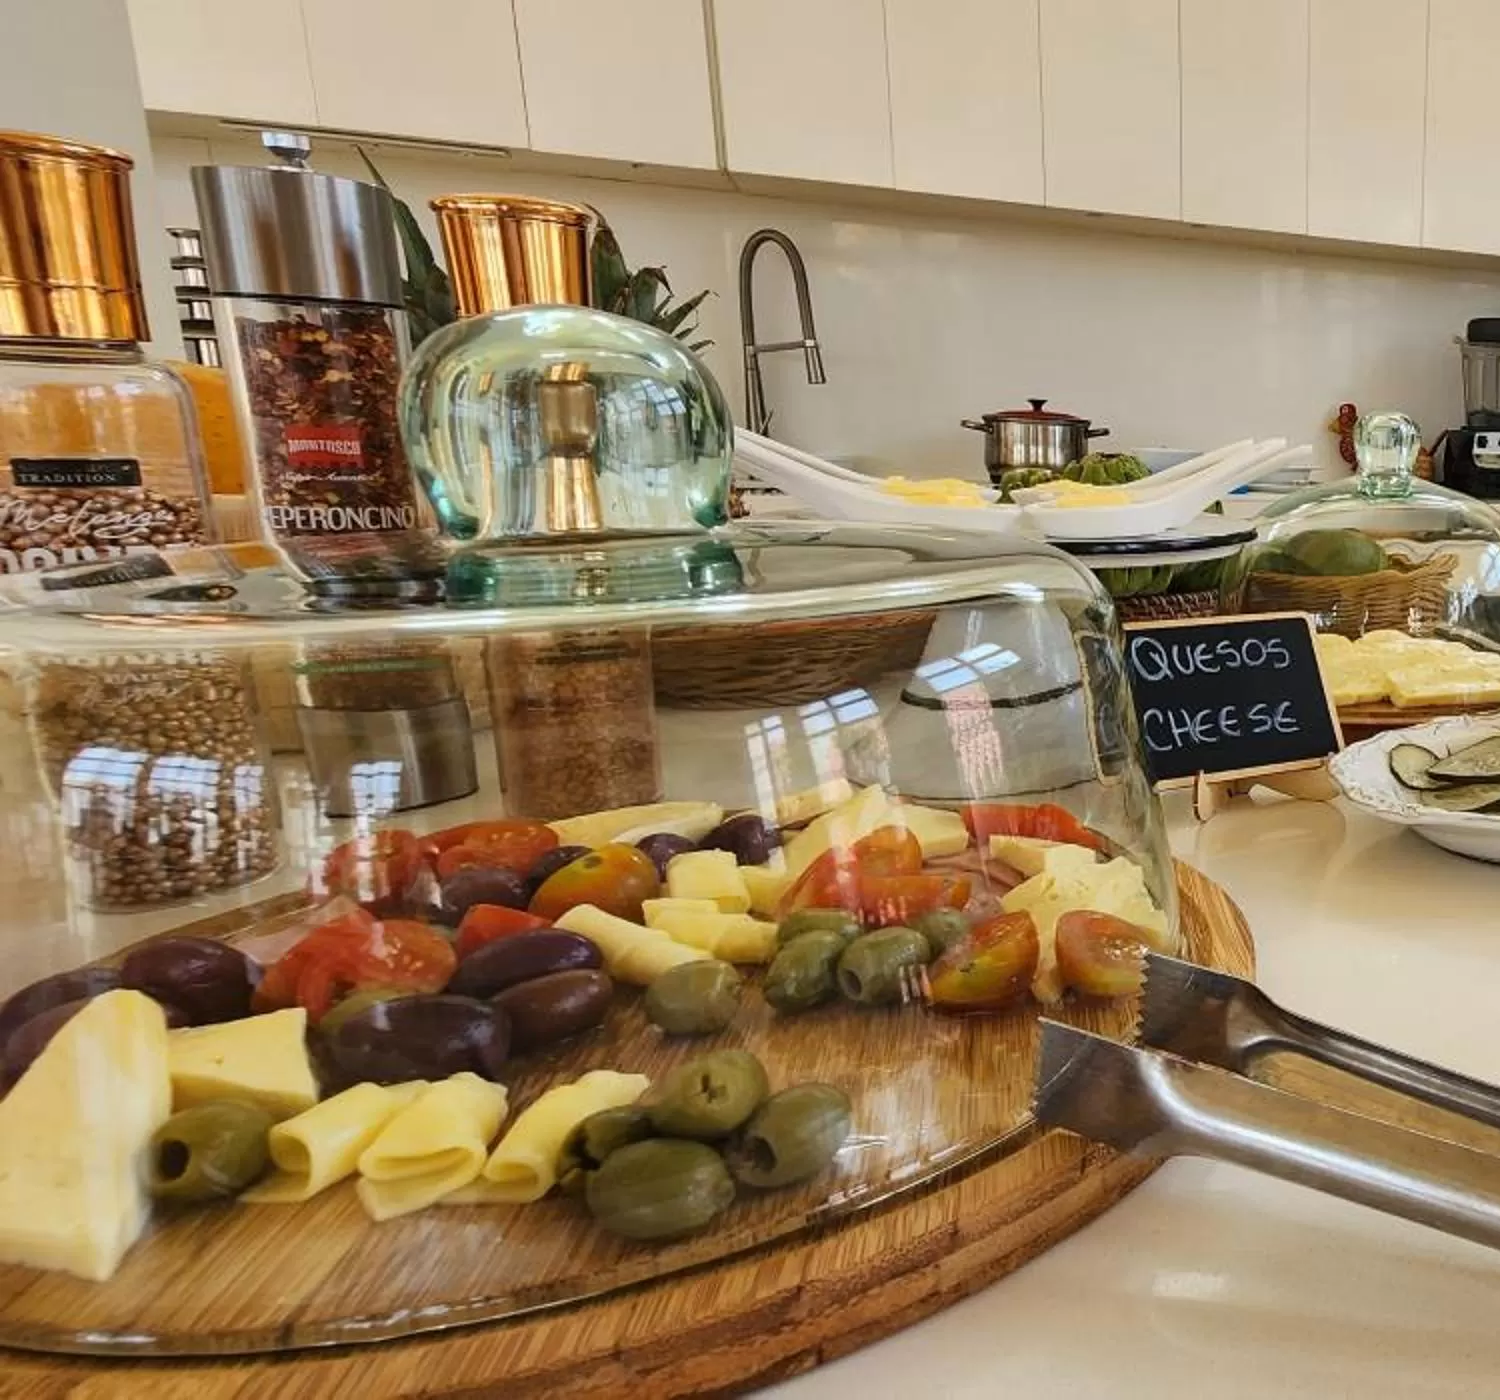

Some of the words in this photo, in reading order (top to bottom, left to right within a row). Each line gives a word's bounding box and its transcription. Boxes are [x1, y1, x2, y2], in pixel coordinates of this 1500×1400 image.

[18, 472, 119, 483] TRADITION
[1130, 636, 1291, 682] QUESOS
[1143, 701, 1301, 751] CHEESE
